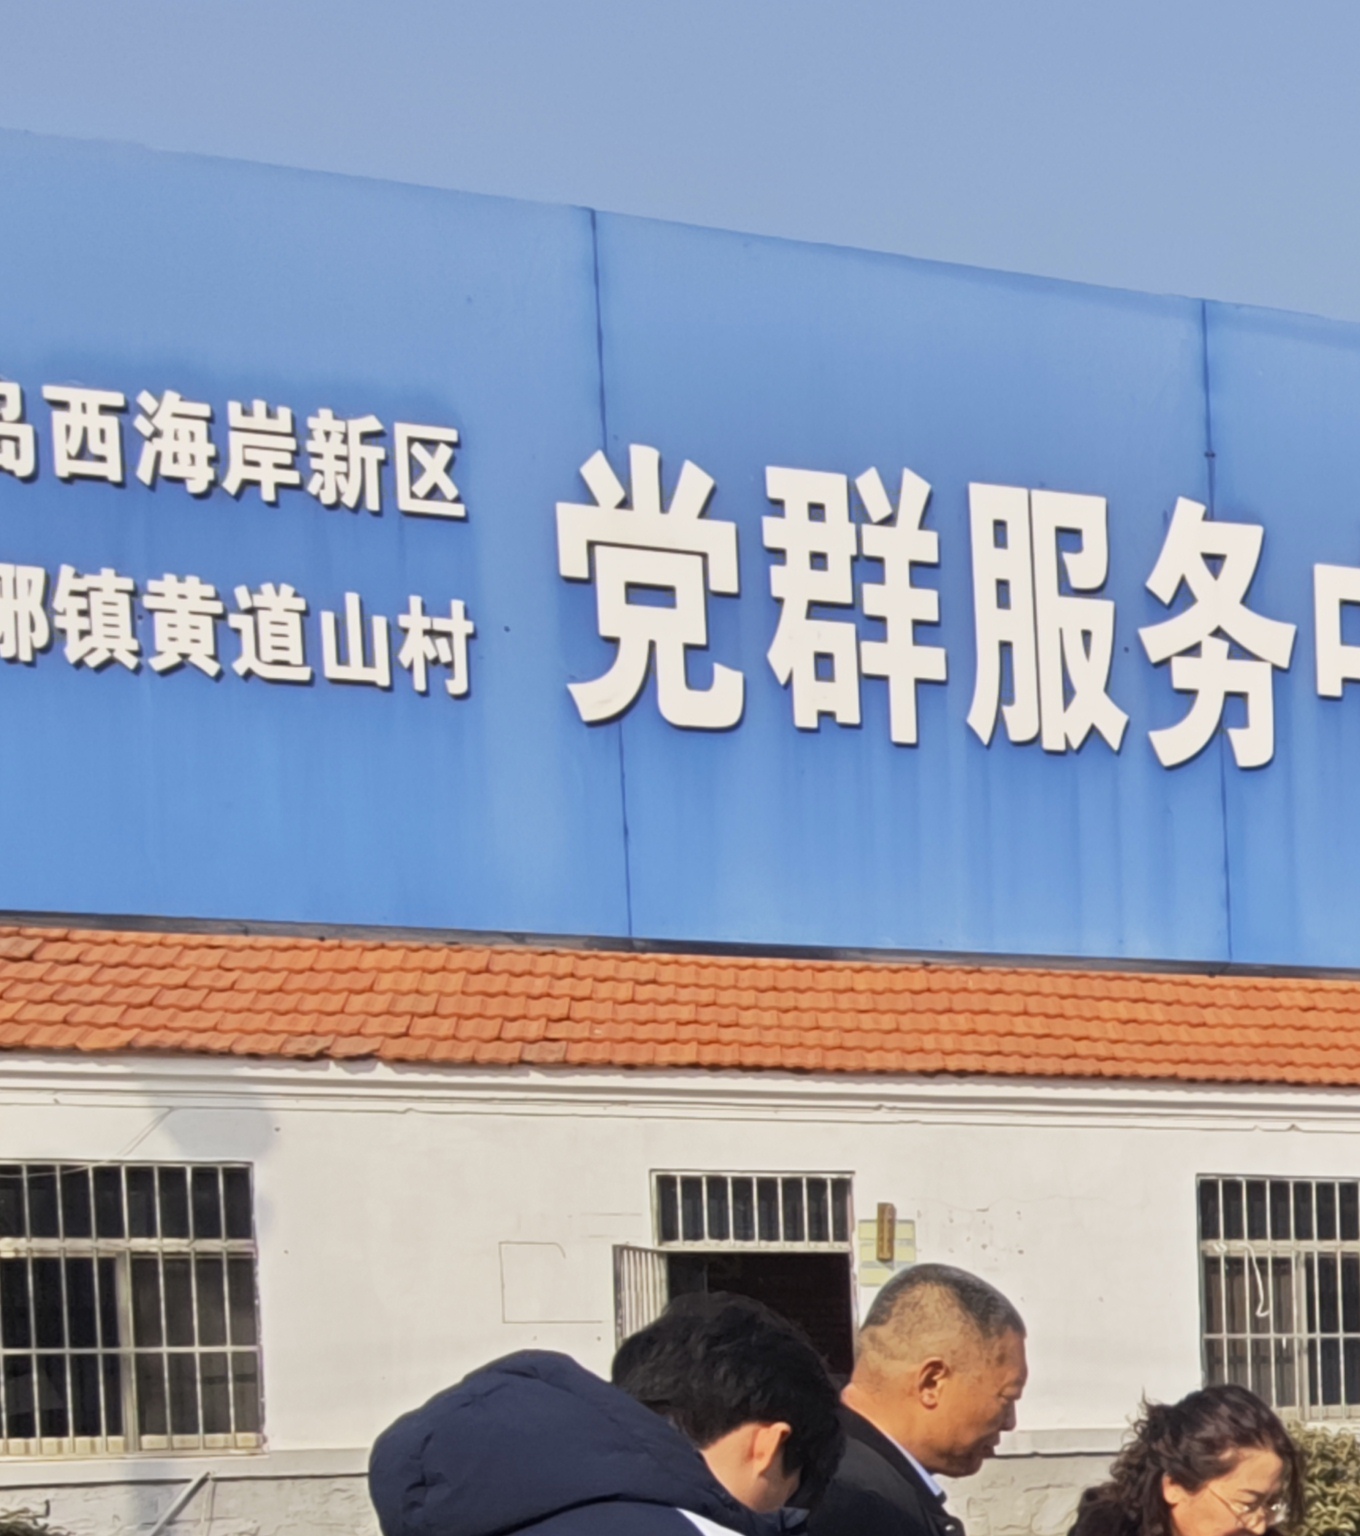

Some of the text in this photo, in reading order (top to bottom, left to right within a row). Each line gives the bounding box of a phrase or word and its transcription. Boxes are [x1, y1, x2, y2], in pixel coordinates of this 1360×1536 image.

[0, 562, 474, 696] 琊镇黄道山村
